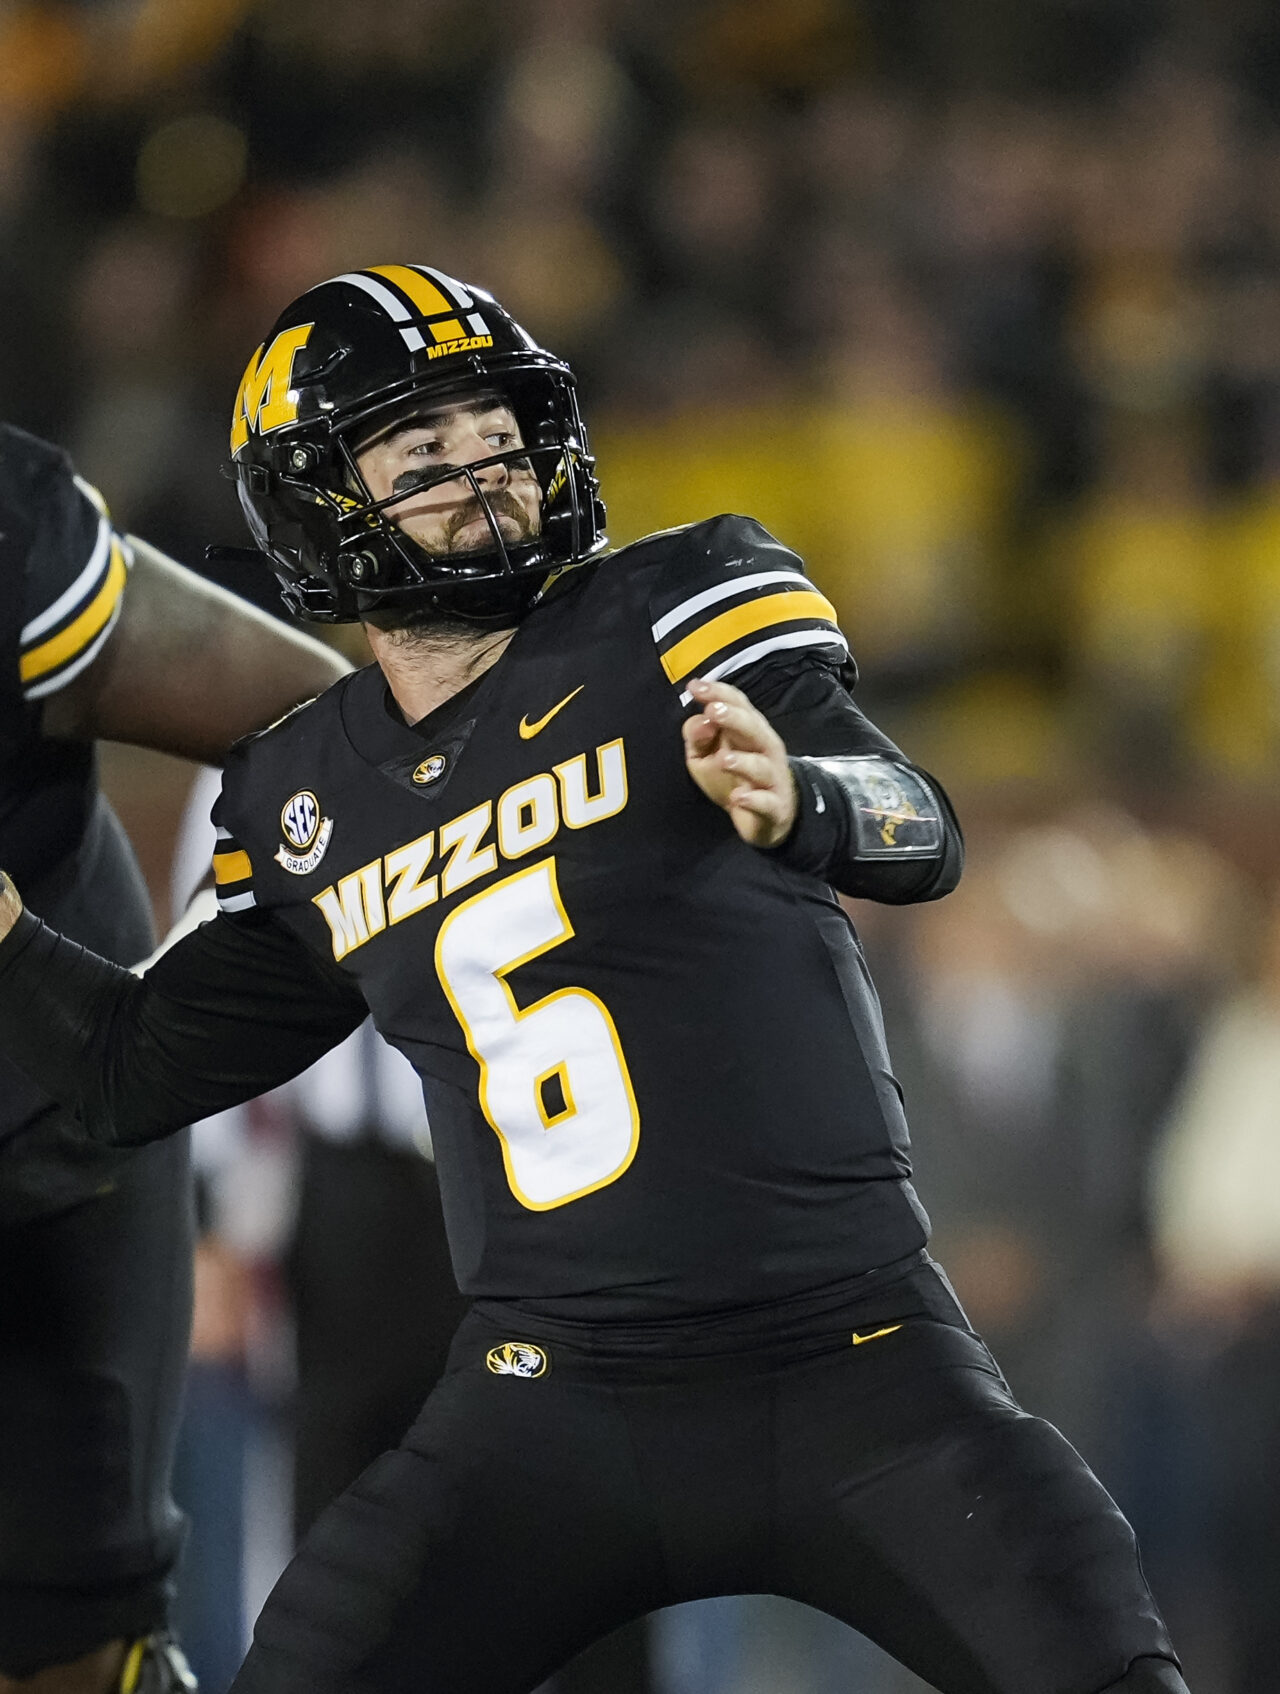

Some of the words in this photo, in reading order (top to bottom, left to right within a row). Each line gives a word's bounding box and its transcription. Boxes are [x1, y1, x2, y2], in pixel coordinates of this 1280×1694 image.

[229, 321, 315, 460] M
[426, 335, 494, 361] MIZZOU
[282, 793, 318, 846] SEC
[285, 836, 326, 872] GRADUATE
[311, 737, 629, 963] MIZZOU
[434, 855, 642, 1212] 6
